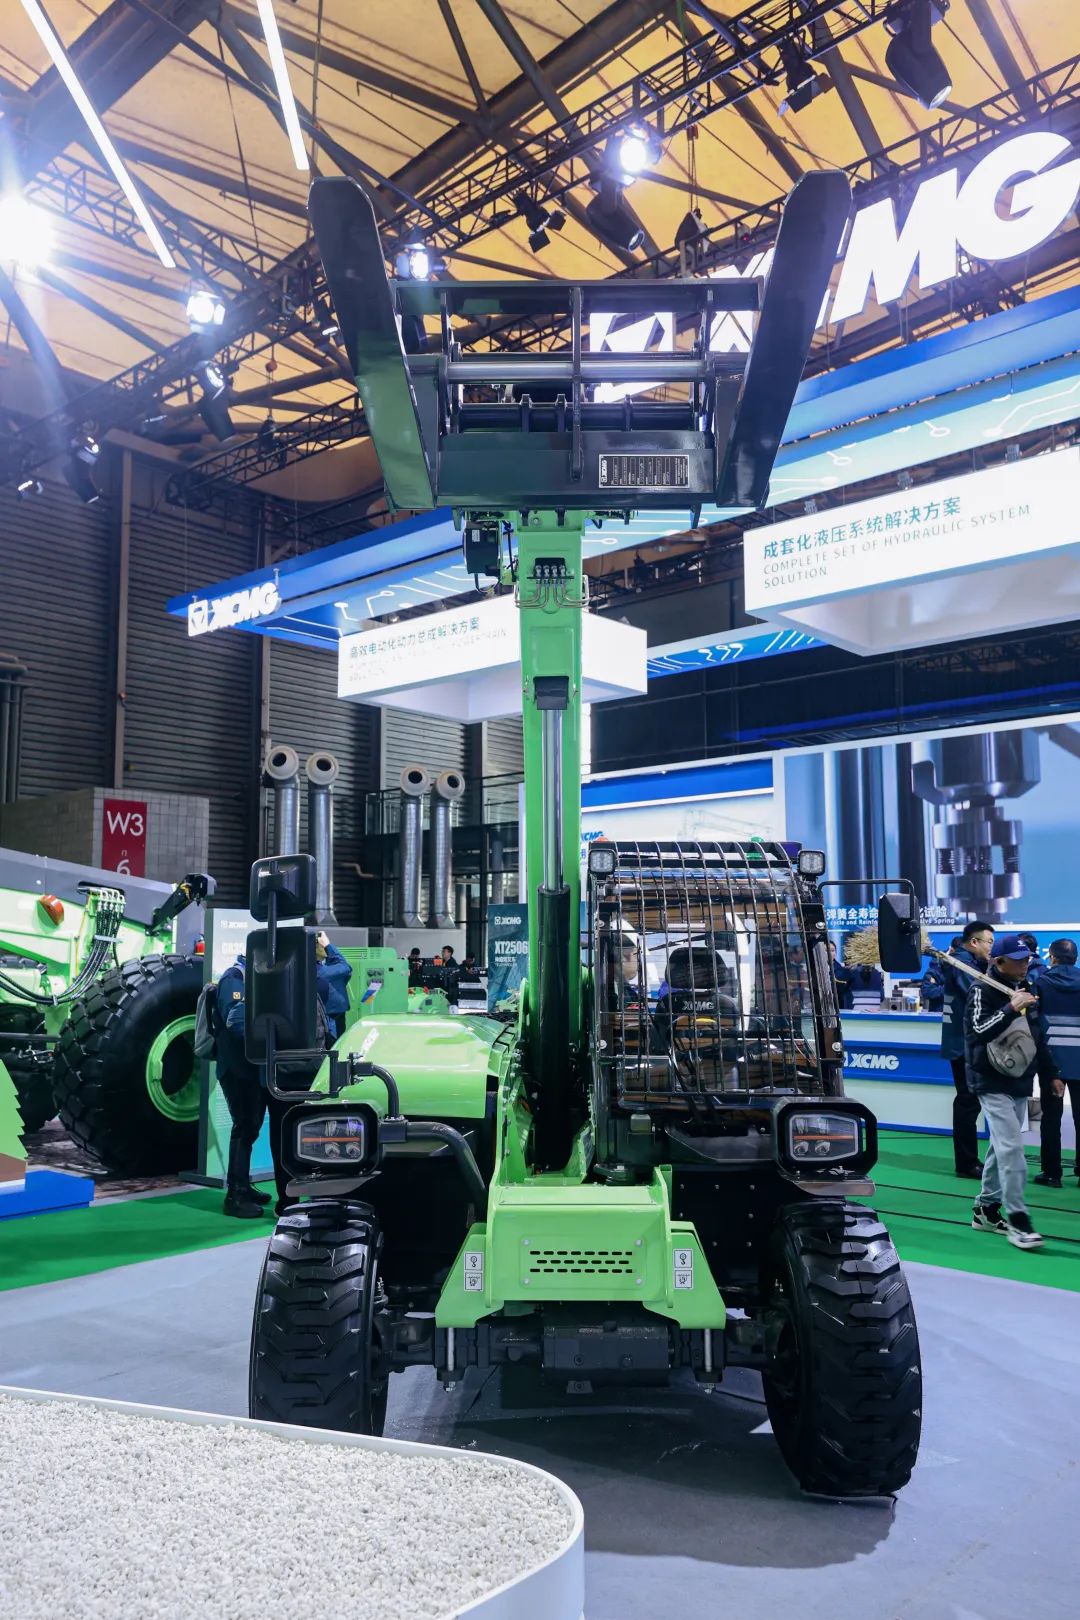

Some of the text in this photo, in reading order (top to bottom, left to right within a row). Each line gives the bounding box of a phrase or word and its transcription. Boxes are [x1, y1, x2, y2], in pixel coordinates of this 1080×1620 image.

[763, 496, 961, 559] 成套化液压系统解决方案
[763, 503, 1031, 575] COMPLETE SET OF HYDRAULIC SYSTEM
[763, 566, 828, 588] SOLUTION
[207, 582, 280, 632] XCMG
[107, 811, 144, 836] W3
[117, 859, 131, 876] 6
[849, 1053, 899, 1071] XCMG
